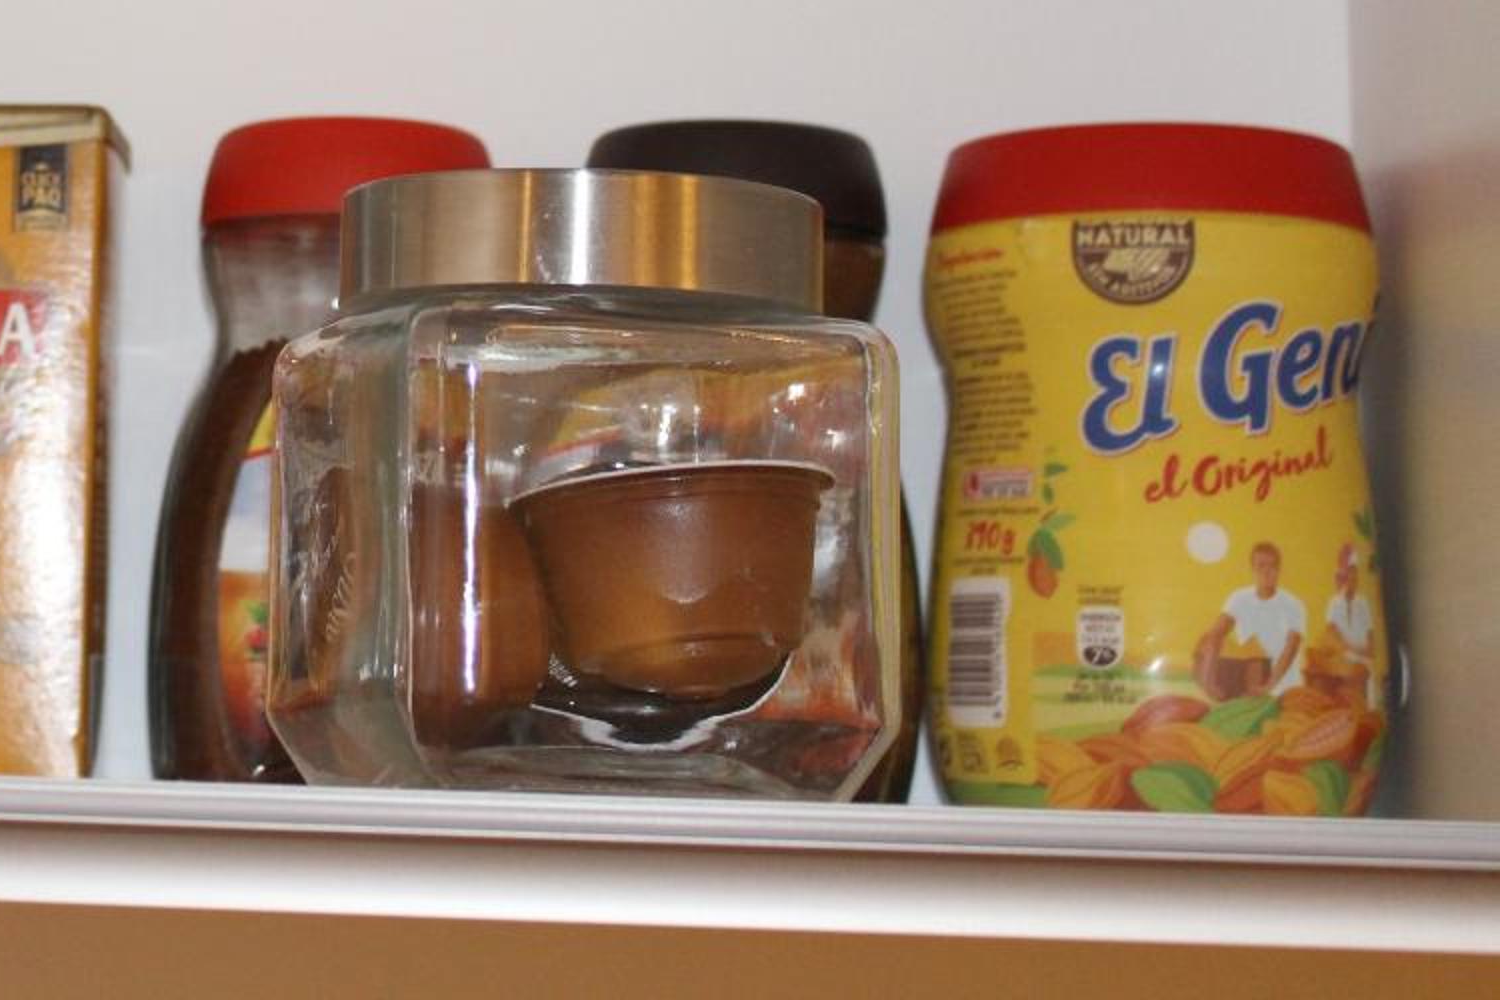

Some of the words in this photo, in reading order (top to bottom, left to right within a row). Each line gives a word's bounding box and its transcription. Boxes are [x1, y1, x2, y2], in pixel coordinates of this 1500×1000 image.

[1076, 226, 1190, 246] NATURAL
[1082, 334, 1179, 454] El
[1143, 453, 1189, 504] el
[1192, 422, 1334, 504] Original
